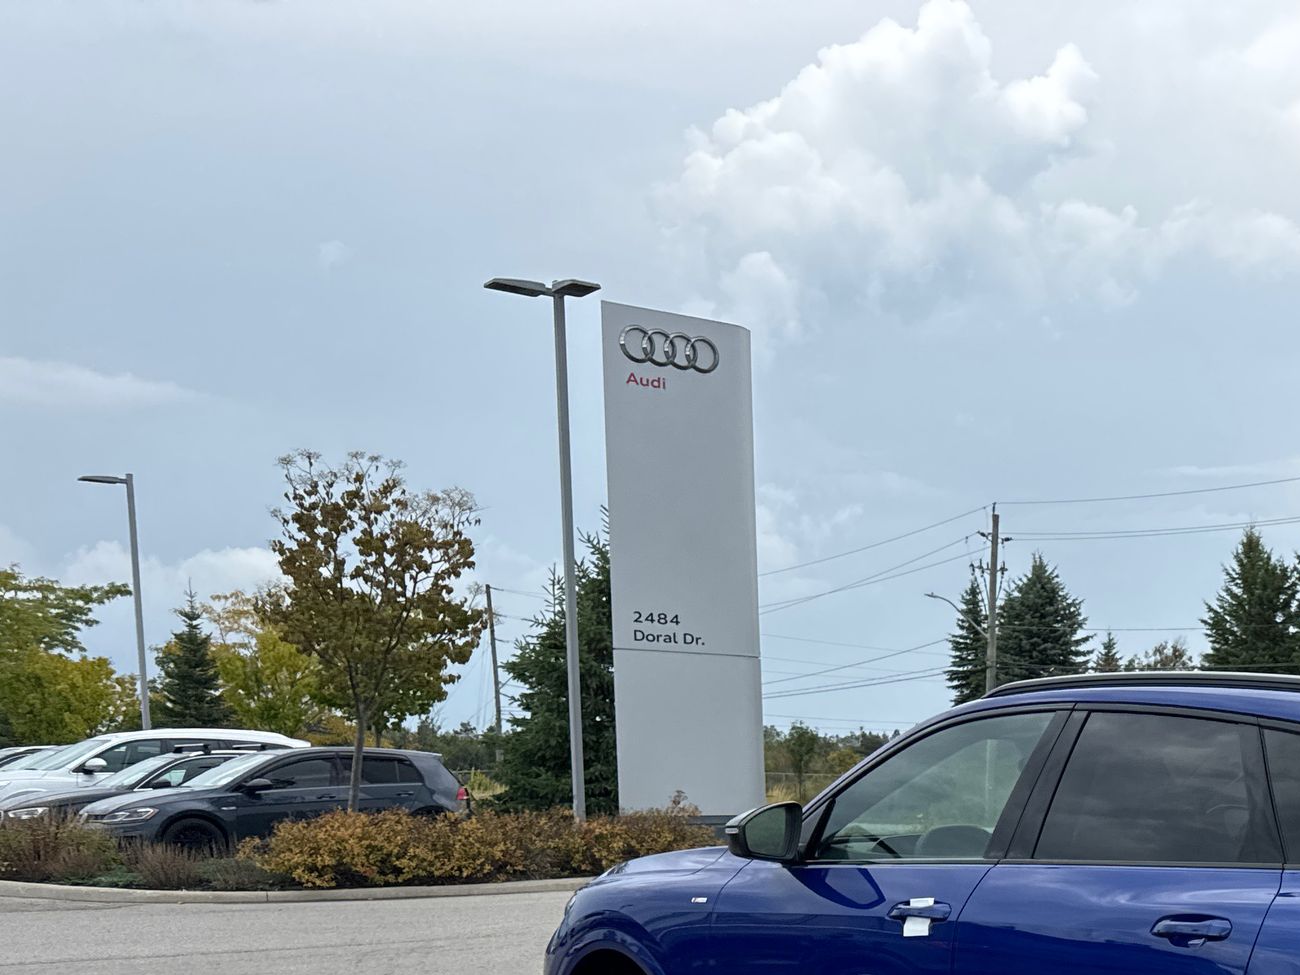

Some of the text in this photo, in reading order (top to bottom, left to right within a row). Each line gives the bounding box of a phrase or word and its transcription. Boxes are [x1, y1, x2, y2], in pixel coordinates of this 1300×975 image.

[626, 372, 666, 390] Audi
[633, 610, 681, 626] 2484
[633, 629, 705, 646] Doral Dr.
